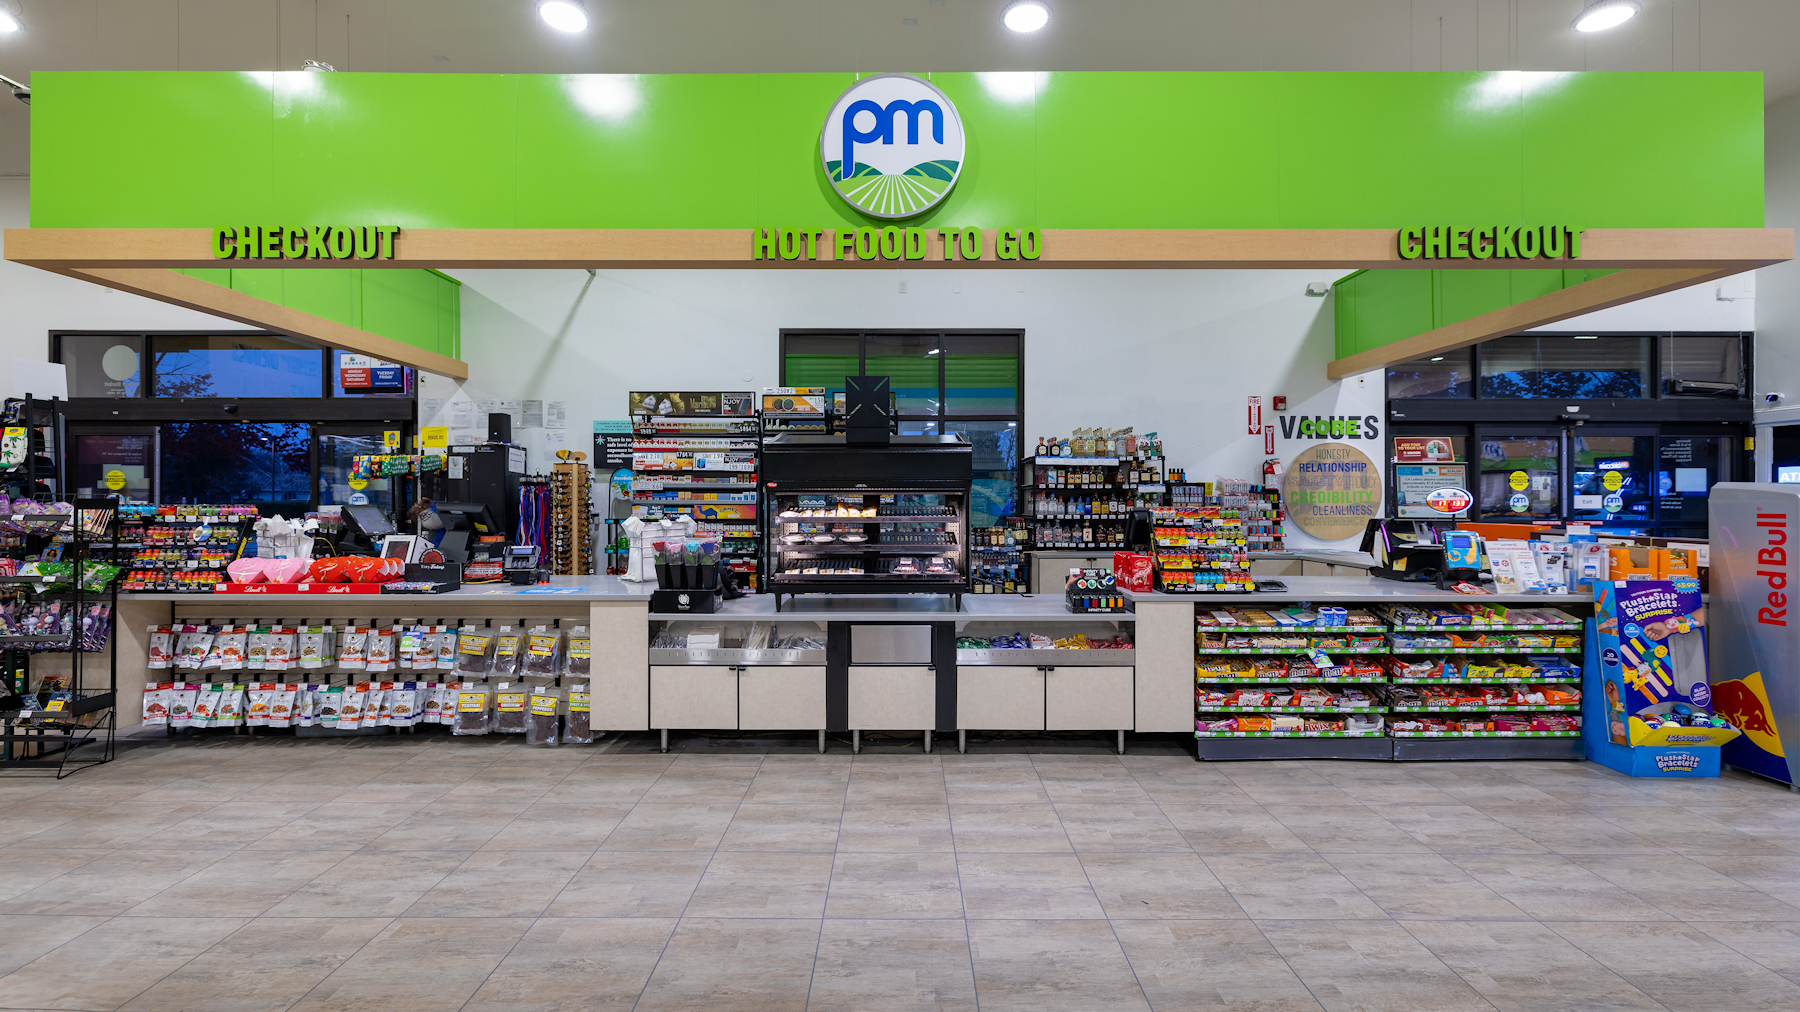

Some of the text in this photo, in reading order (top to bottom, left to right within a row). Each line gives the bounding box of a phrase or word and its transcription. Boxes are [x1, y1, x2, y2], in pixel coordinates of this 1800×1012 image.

[842, 99, 944, 180] pm
[212, 225, 400, 259] CHECKOUT
[754, 225, 1042, 260] HOT FOOD TO GO
[1397, 224, 1586, 259] CHECKOUT
[1300, 420, 1358, 436] CORE
[1315, 449, 1351, 460] HONESTY
[1298, 462, 1367, 473] RELATIONSHIP
[1288, 476, 1377, 488] SAFETY EFFICIENCY
[1780, 472, 1800, 481] AT
[1290, 490, 1373, 504] CREDIBILITY
[1512, 498, 1526, 507] pm
[1606, 498, 1620, 507] pm
[1312, 505, 1373, 516] CLEANLINESS
[1304, 516, 1365, 526] CONVENIENCE
[1757, 513, 1787, 566] Bull
[1620, 592, 1678, 609] Plush Slap
[1757, 570, 1787, 626] Red
[1625, 600, 1680, 617] Bracelets
[1635, 609, 1674, 622] SURPRISE
[1305, 723, 1329, 731] TWIX
[1682, 755, 1700, 763] Slap
